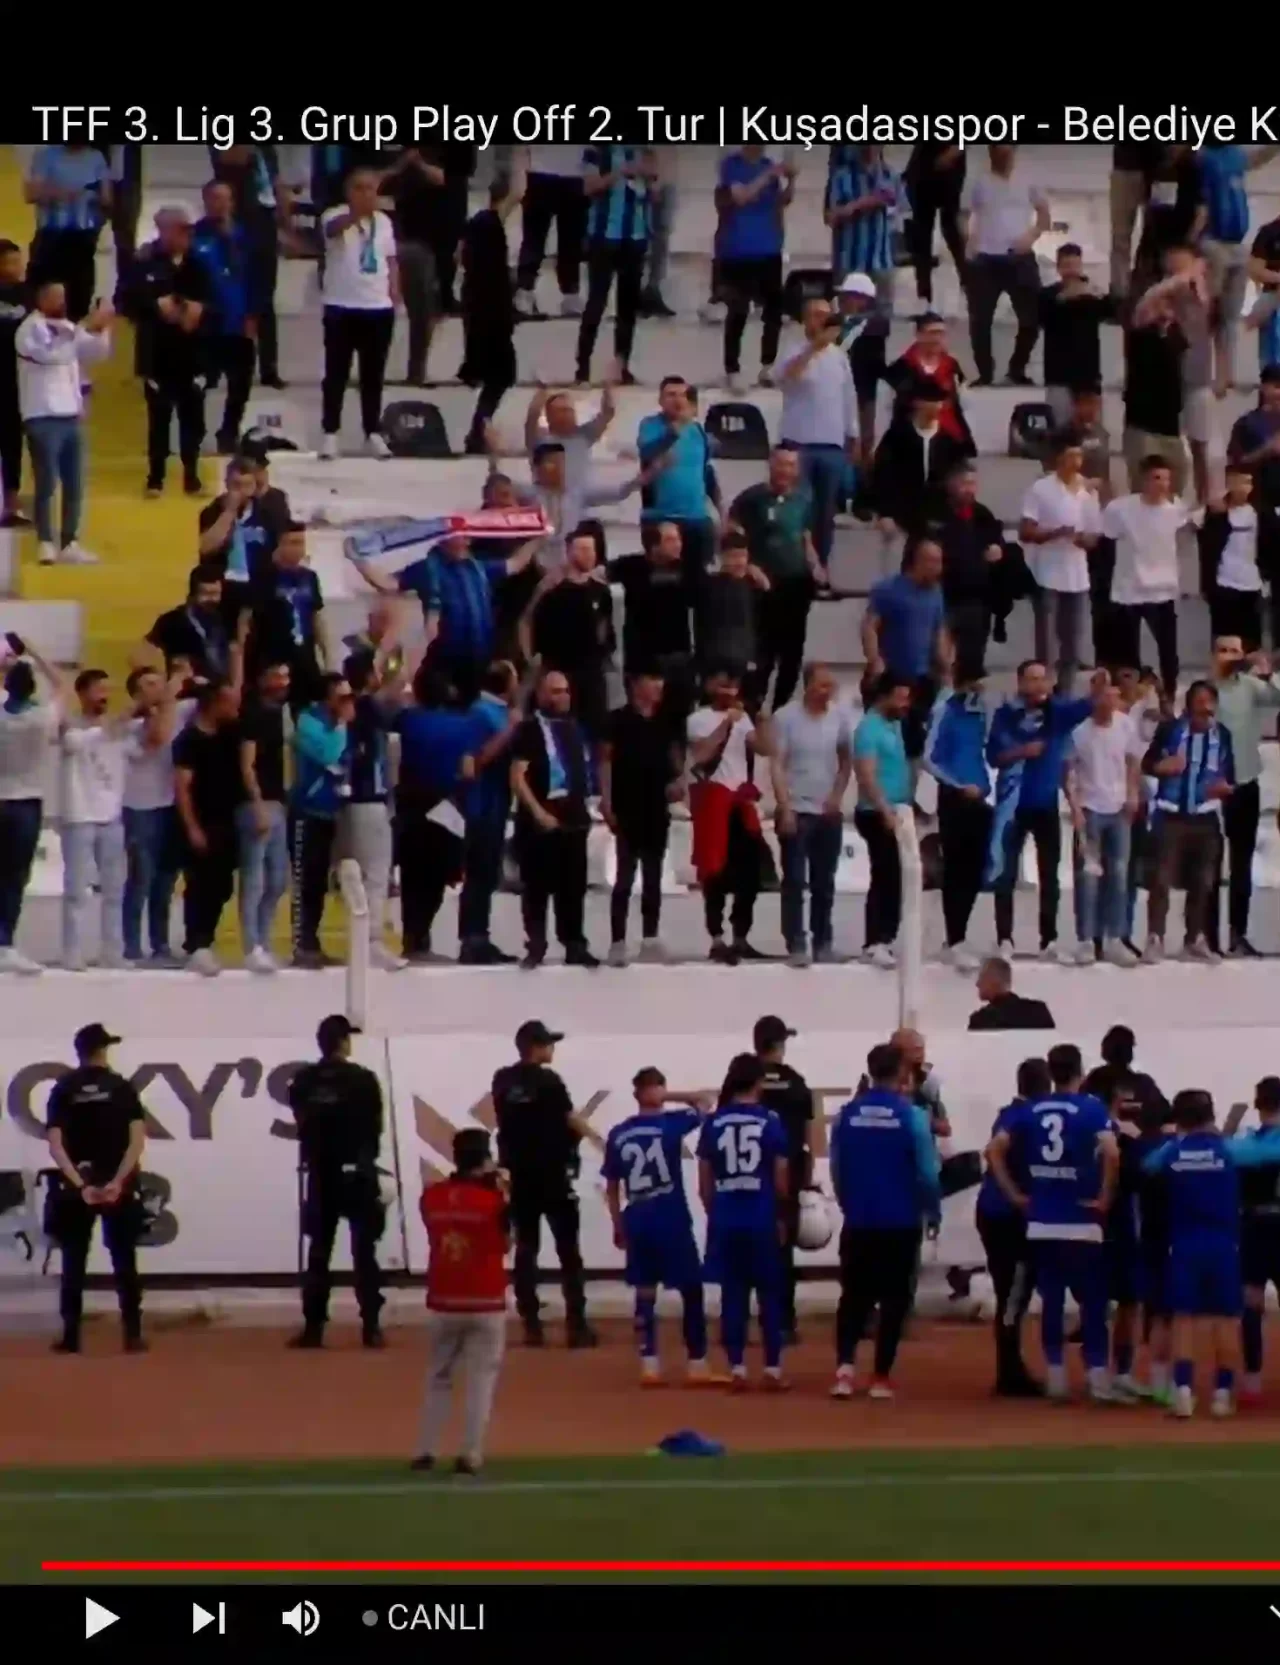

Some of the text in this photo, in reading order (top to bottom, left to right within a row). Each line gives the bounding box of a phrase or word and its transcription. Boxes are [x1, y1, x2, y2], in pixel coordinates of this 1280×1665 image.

[717, 1125, 763, 1175] 15
[1041, 1113, 1064, 1162] 3
[621, 1138, 671, 1192] 21
